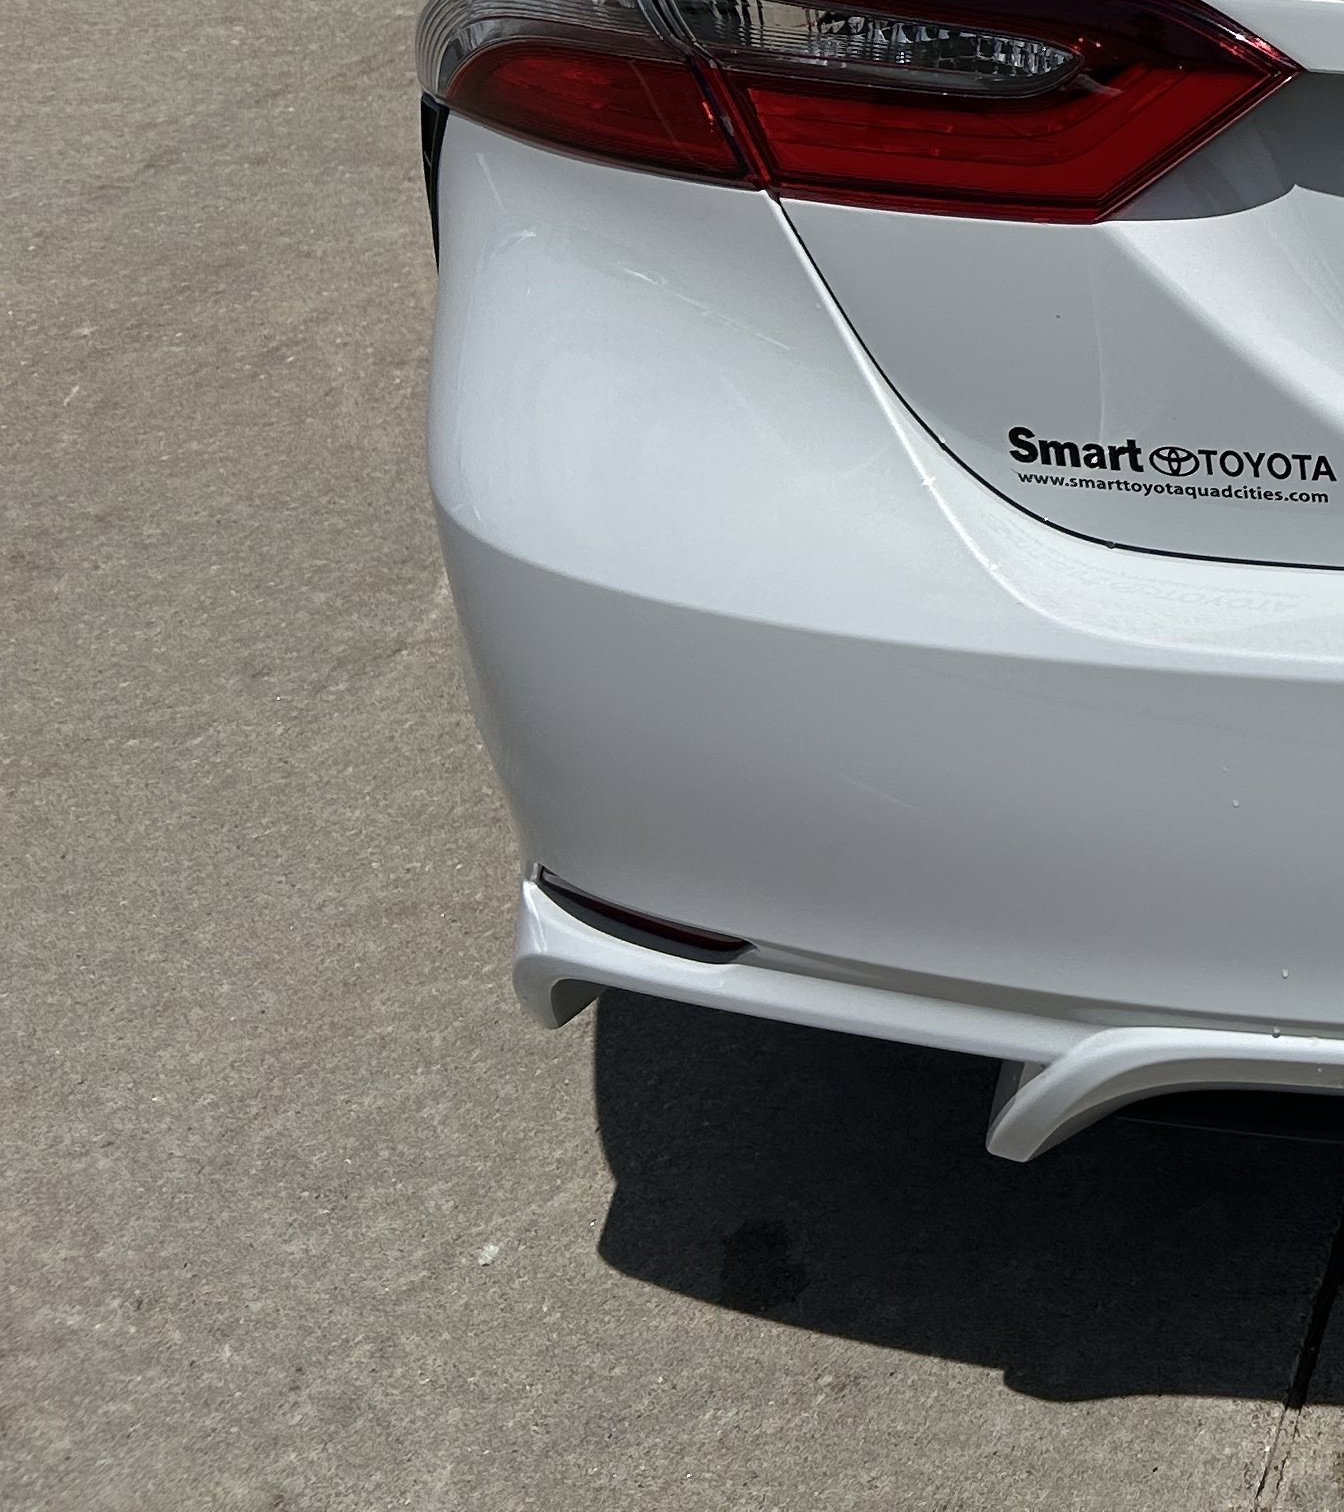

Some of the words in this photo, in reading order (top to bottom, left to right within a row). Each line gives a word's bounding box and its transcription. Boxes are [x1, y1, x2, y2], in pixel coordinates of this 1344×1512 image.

[1007, 426, 1145, 473] Smart
[1197, 449, 1337, 482] TOYOTA
[1017, 472, 1330, 504] www.smarttoyotaquadcities.com
